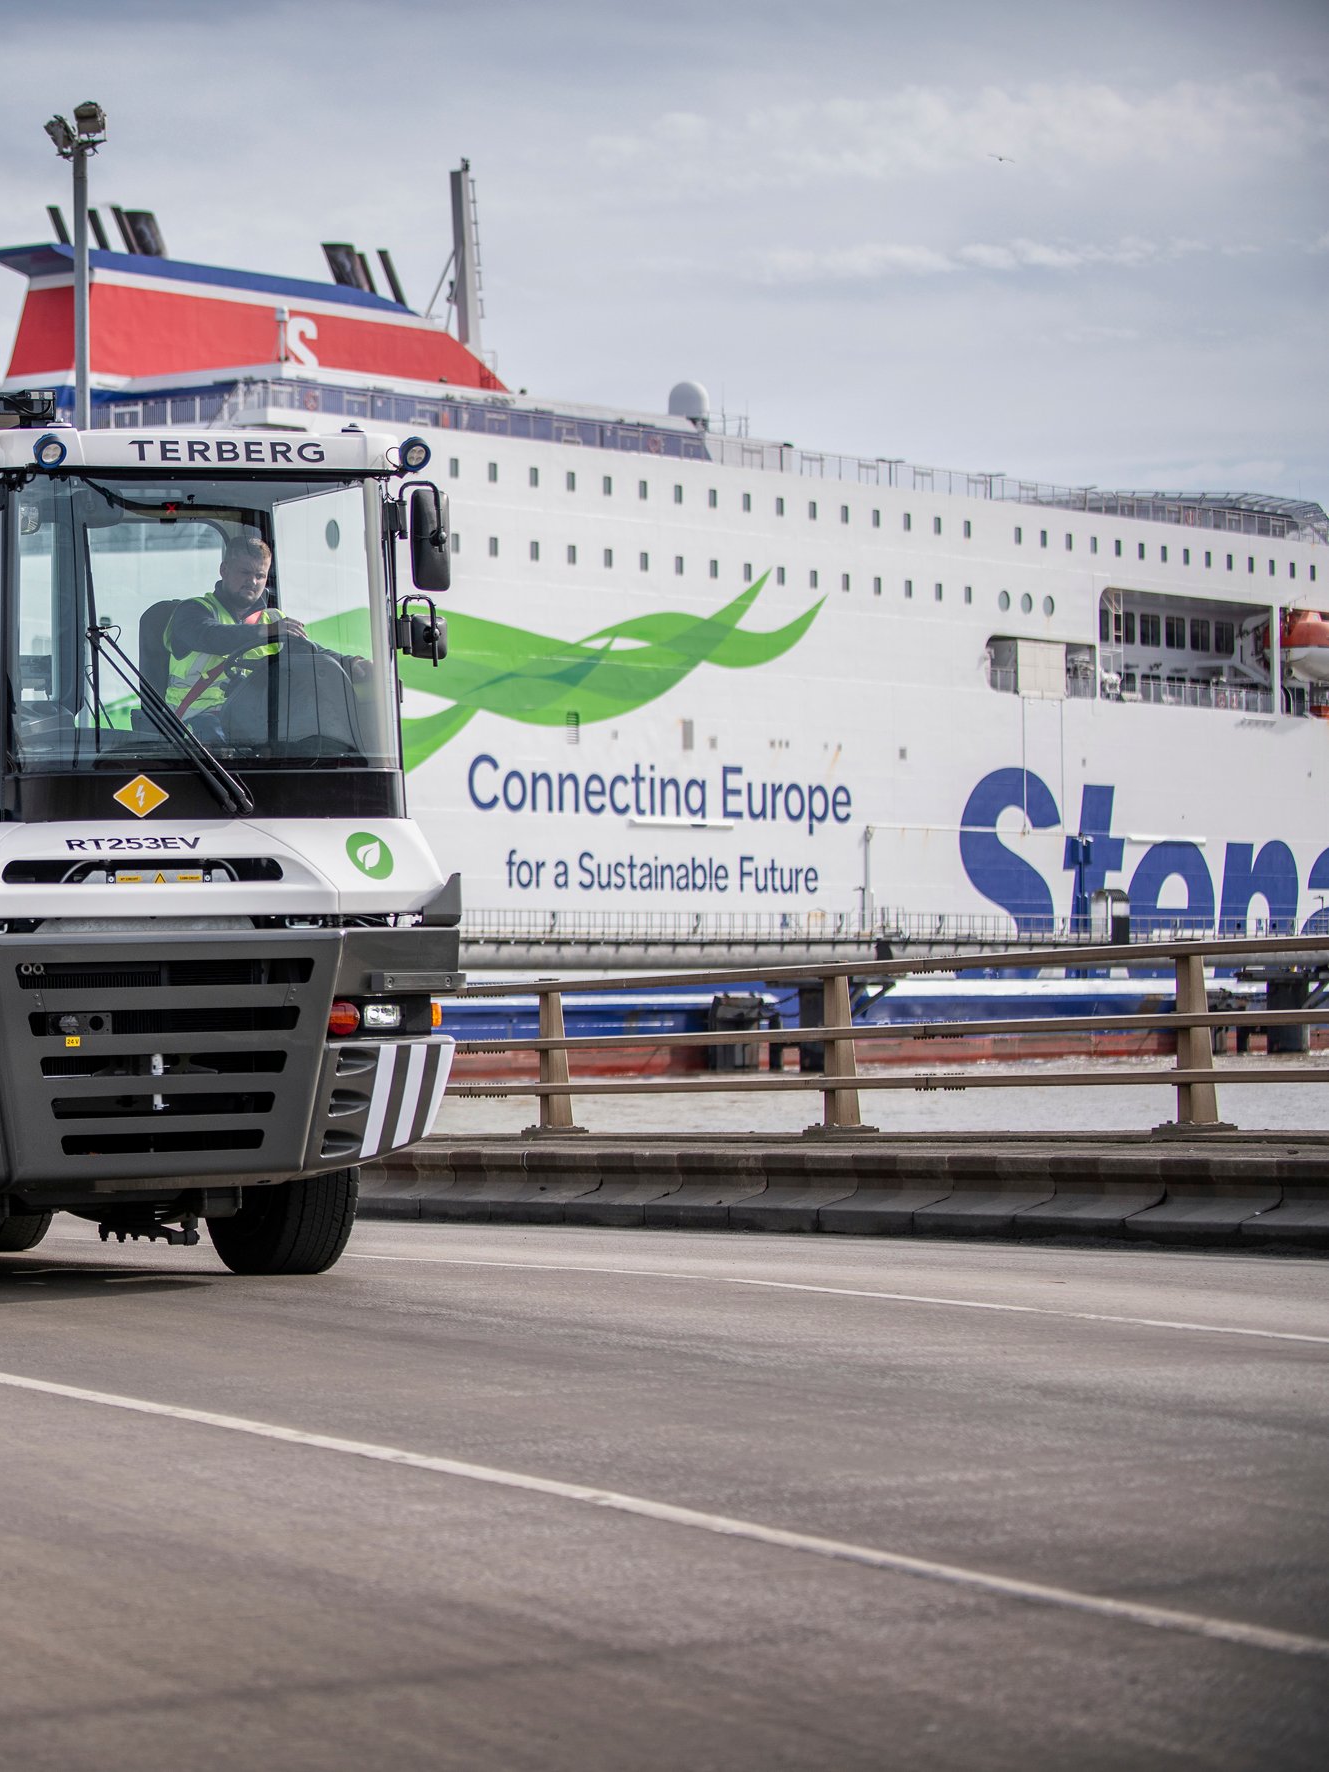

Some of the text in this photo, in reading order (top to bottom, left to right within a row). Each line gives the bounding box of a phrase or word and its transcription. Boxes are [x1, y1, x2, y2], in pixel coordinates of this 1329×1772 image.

[127, 440, 326, 463] TERBERG
[467, 754, 852, 835] Connecting Europe
[65, 837, 200, 851] RT253EV
[505, 849, 819, 894] for a Sustainable Future
[959, 767, 1329, 978] Sten
